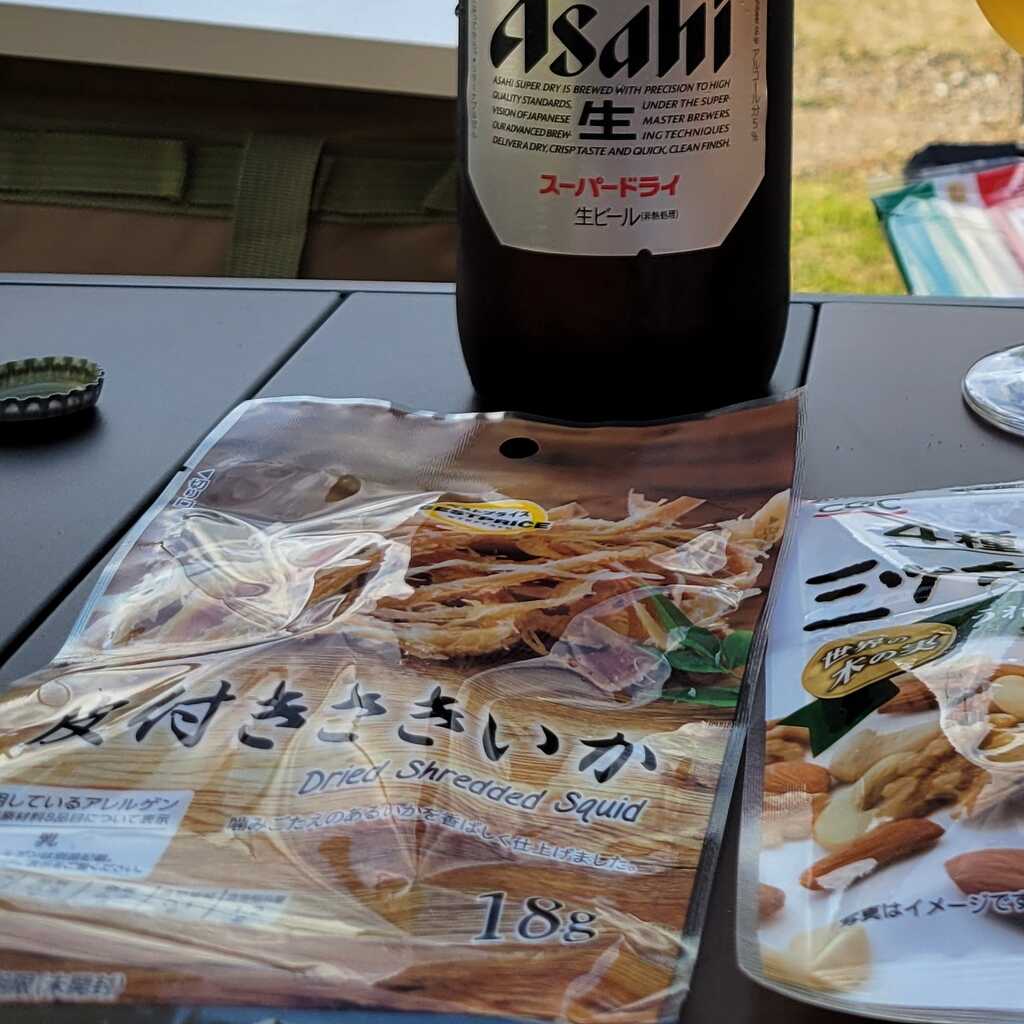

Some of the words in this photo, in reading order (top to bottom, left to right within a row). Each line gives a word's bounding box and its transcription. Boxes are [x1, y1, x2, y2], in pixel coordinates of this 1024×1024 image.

[493, 76, 514, 86] ASAHI
[516, 80, 541, 90] SUPER
[543, 83, 561, 93] DRY
[562, 84, 571, 94] IS
[573, 85, 613, 95] BREWED
[615, 86, 642, 95] WITH
[644, 83, 695, 95] PRECISION
[696, 82, 709, 91] TO
[709, 79, 731, 88] HIGH
[492, 91, 521, 103] QUALITY
[643, 99, 678, 110] UNDER
[680, 97, 701, 108] THE
[492, 106, 516, 117] VISION
[516, 110, 528, 119] OF
[526, 112, 571, 124] JAPANESE
[642, 114, 686, 125] MASTER
[578, 100, 637, 140] 生
[492, 120, 507, 130] OUR
[506, 123, 546, 137] ADVANCED
[642, 130, 665, 140] ING
[664, 123, 730, 139] TECHNIQUES
[492, 135, 522, 149] DELIVER
[549, 144, 576, 154] CRISP
[575, 146, 607, 156] TASTE
[607, 146, 632, 156] AND
[669, 142, 701, 153] CLEAN
[538, 173, 681, 198] スーパードライ
[822, 634, 911, 669] 世界の
[827, 633, 942, 693] 木の実
[298, 760, 390, 795] Dried
[396, 759, 548, 812] Shredded
[554, 791, 648, 824] Squid
[474, 892, 596, 943] 18g
